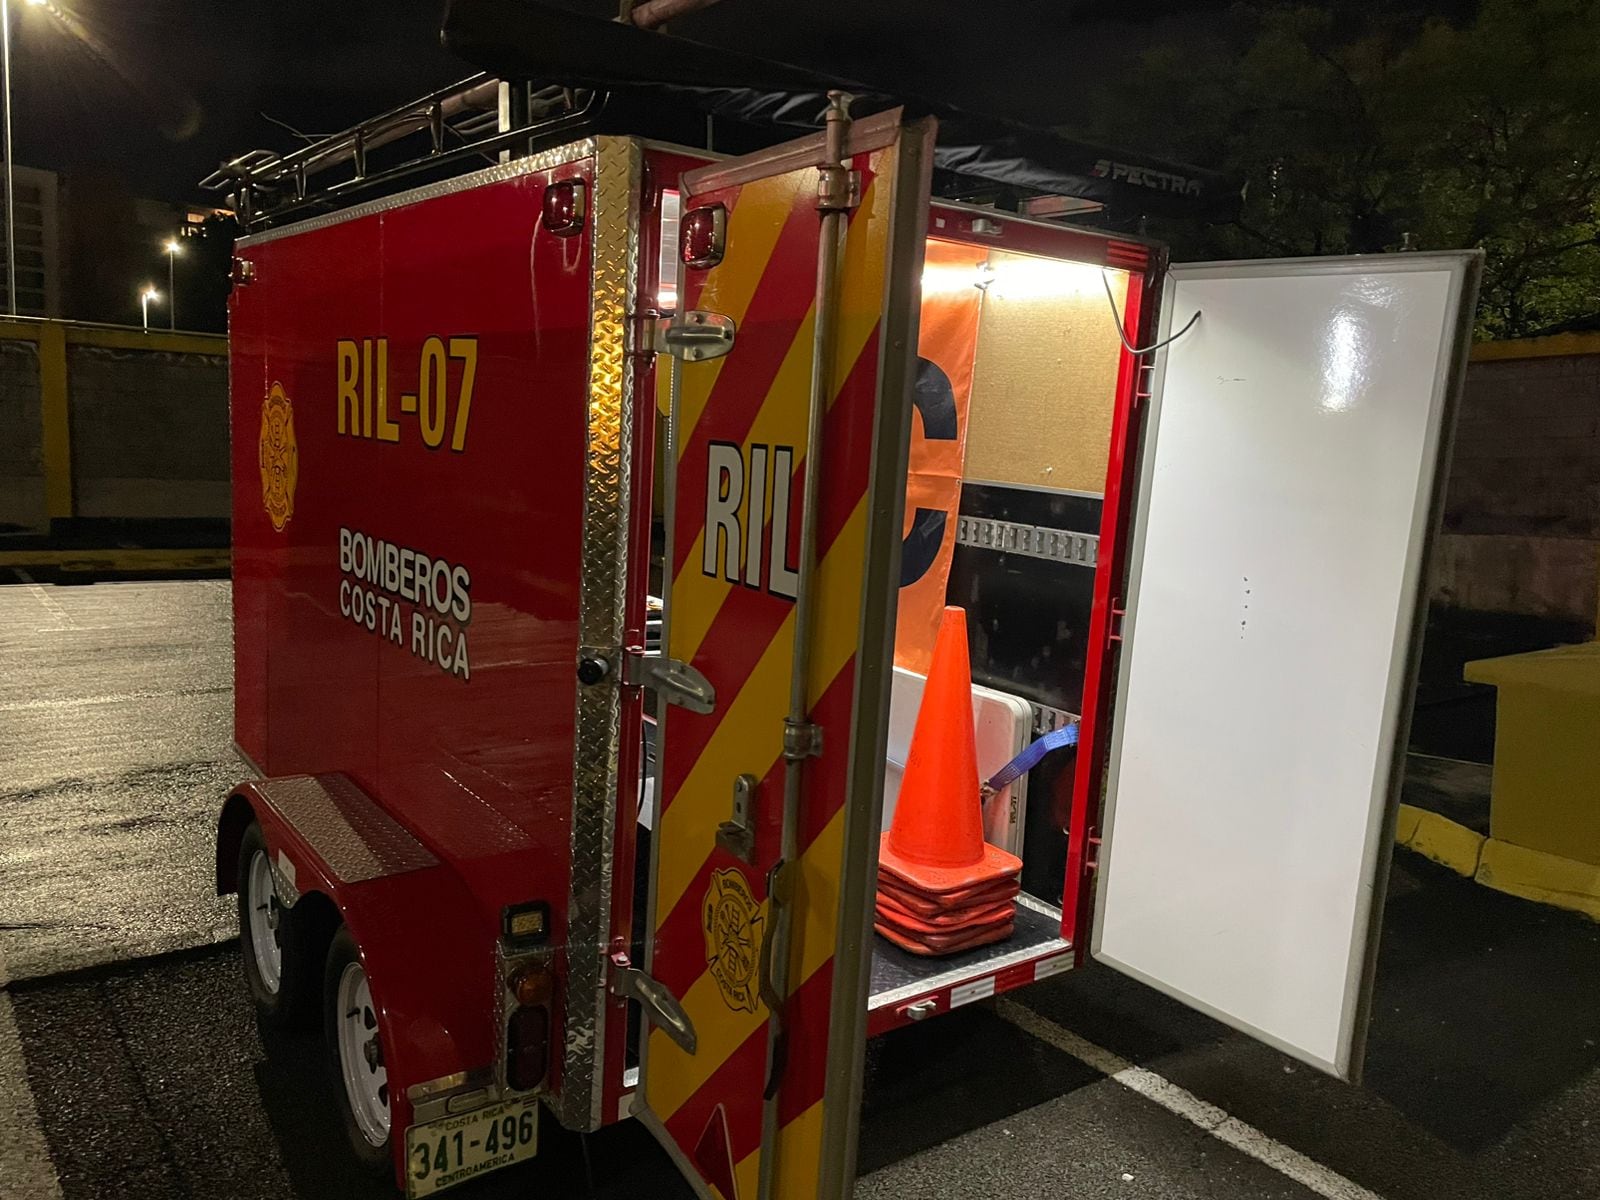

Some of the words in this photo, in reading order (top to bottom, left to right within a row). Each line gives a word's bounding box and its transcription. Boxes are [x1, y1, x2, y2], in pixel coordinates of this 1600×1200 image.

[1090, 159, 1200, 196] SPECTRA
[336, 336, 479, 452] RIL-07
[339, 527, 471, 622] BOMBEROS
[339, 579, 404, 645] COSTA
[411, 610, 471, 680] RICA
[413, 1110, 533, 1180] 341-496
[446, 1115, 479, 1131] COSTA
[482, 1106, 505, 1120] RICA
[435, 1153, 515, 1188] CENTROAMERICA
